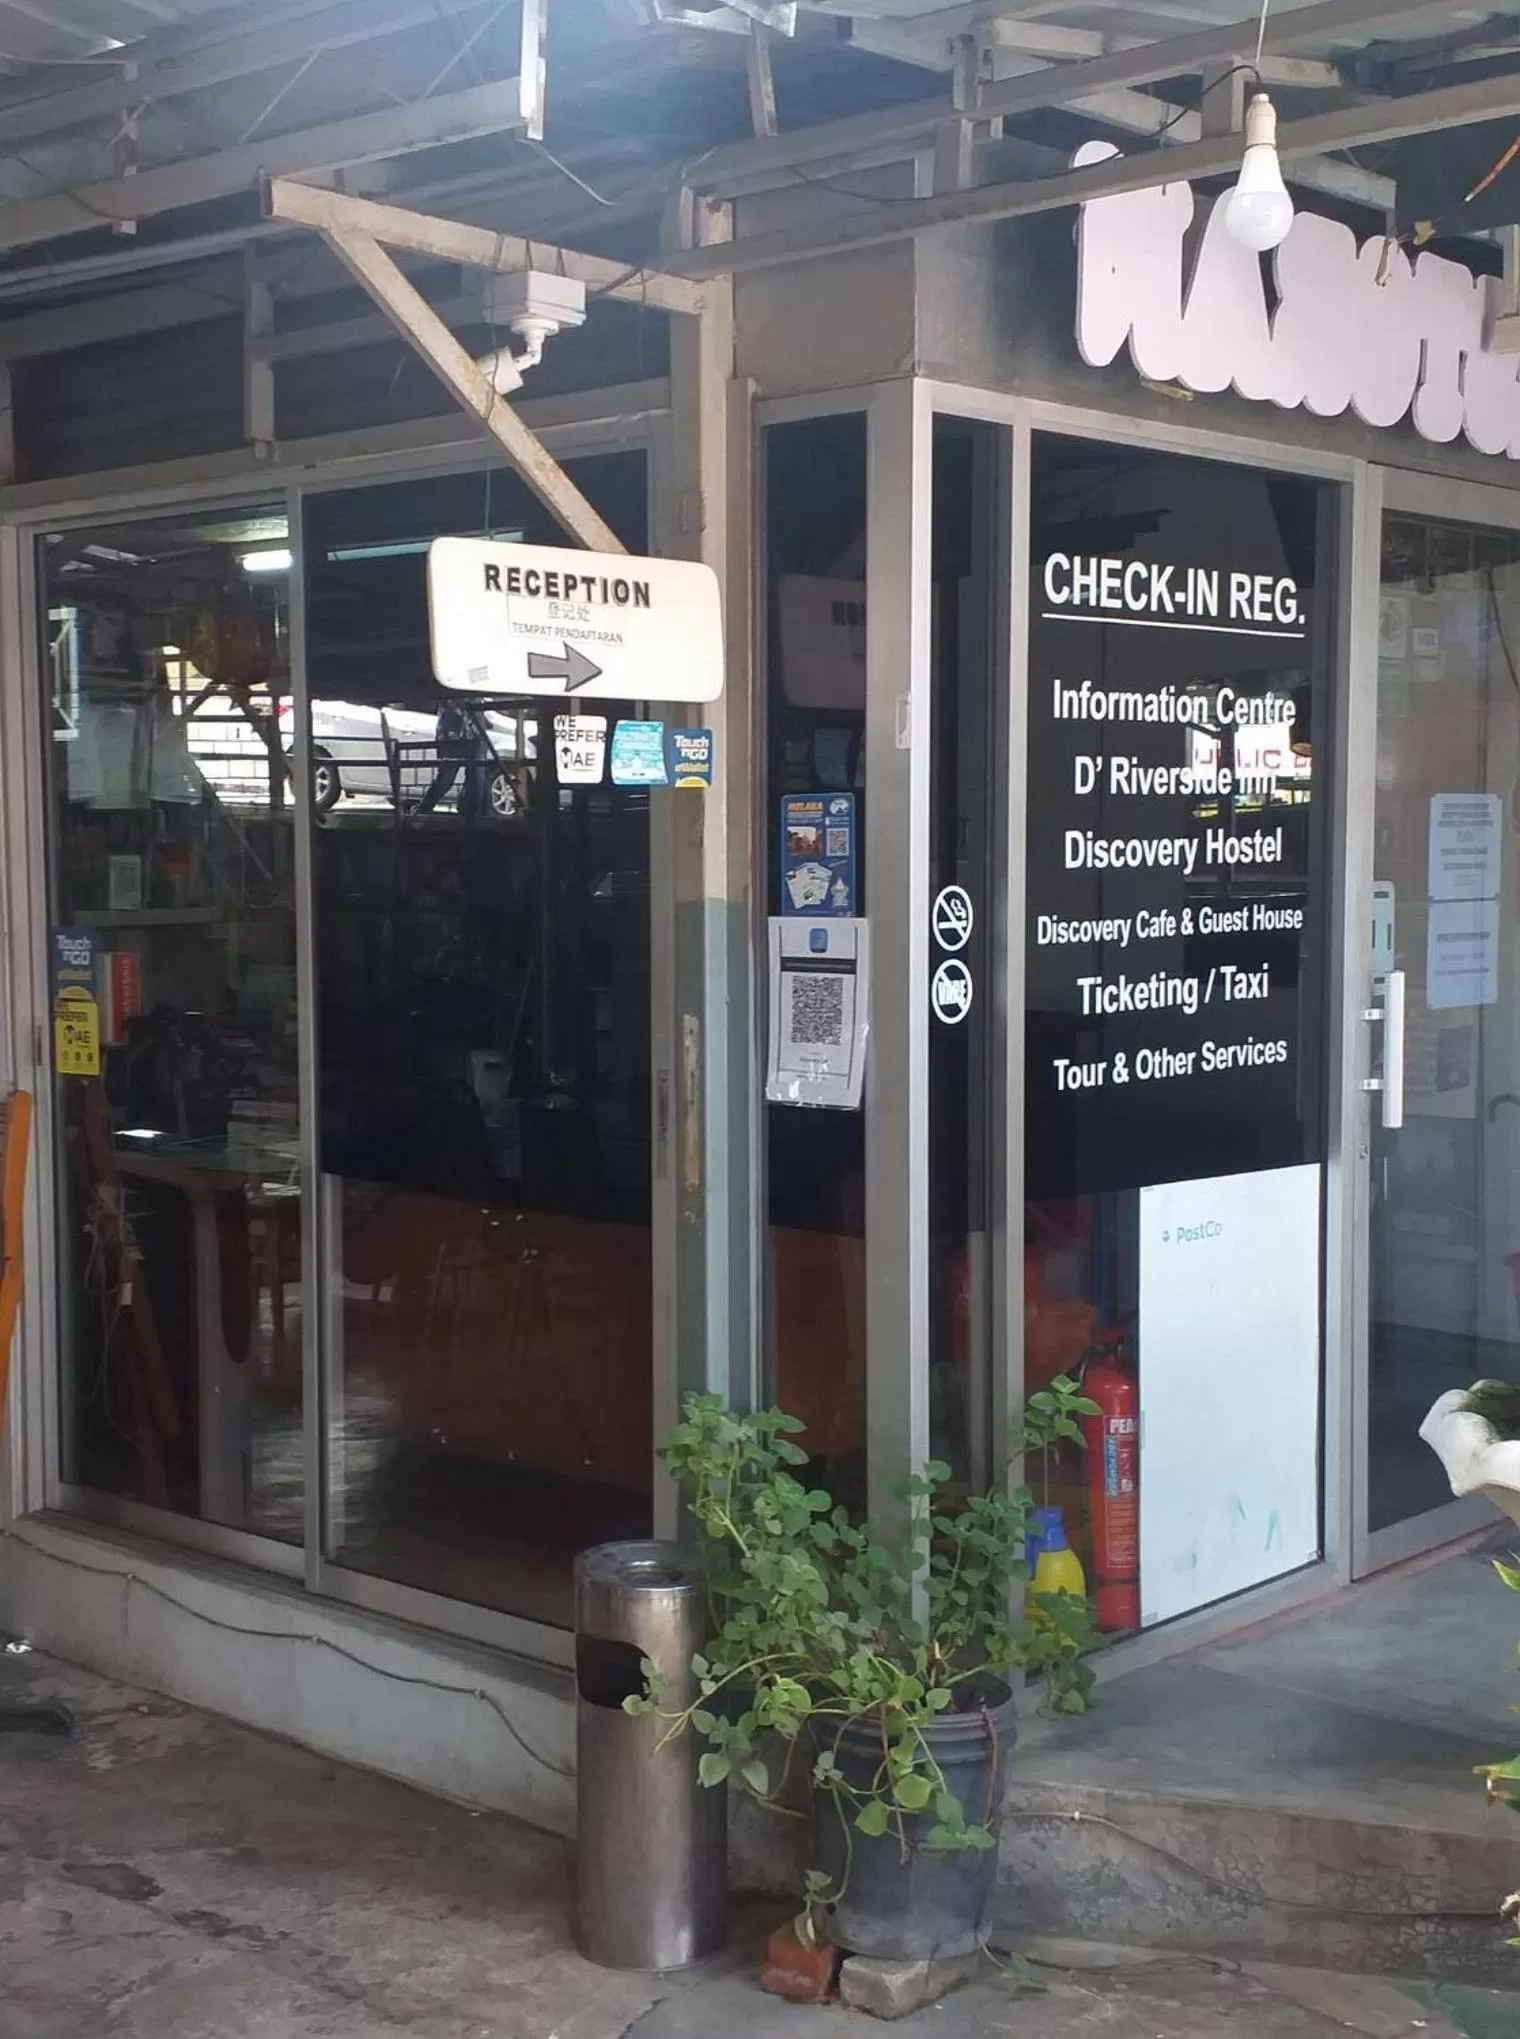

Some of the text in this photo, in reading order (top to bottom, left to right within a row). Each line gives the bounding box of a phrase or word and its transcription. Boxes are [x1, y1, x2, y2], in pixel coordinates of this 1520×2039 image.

[483, 563, 651, 608] RECEPTION
[1044, 552, 1306, 624] CHECK-IN REG.
[512, 622, 553, 636] TEMPAT
[556, 715, 576, 728] WE
[1053, 679, 1297, 728] Information Centre
[674, 734, 709, 748] Touch
[1065, 827, 1283, 875] Discovery Hostel
[1037, 904, 1303, 948] Discovery Cafe & Guest House
[1076, 962, 1269, 1016] Ticketing / Taxi
[1053, 1037, 1287, 1091] Tour & Other Services
[1177, 1220, 1223, 1244] PostCo
